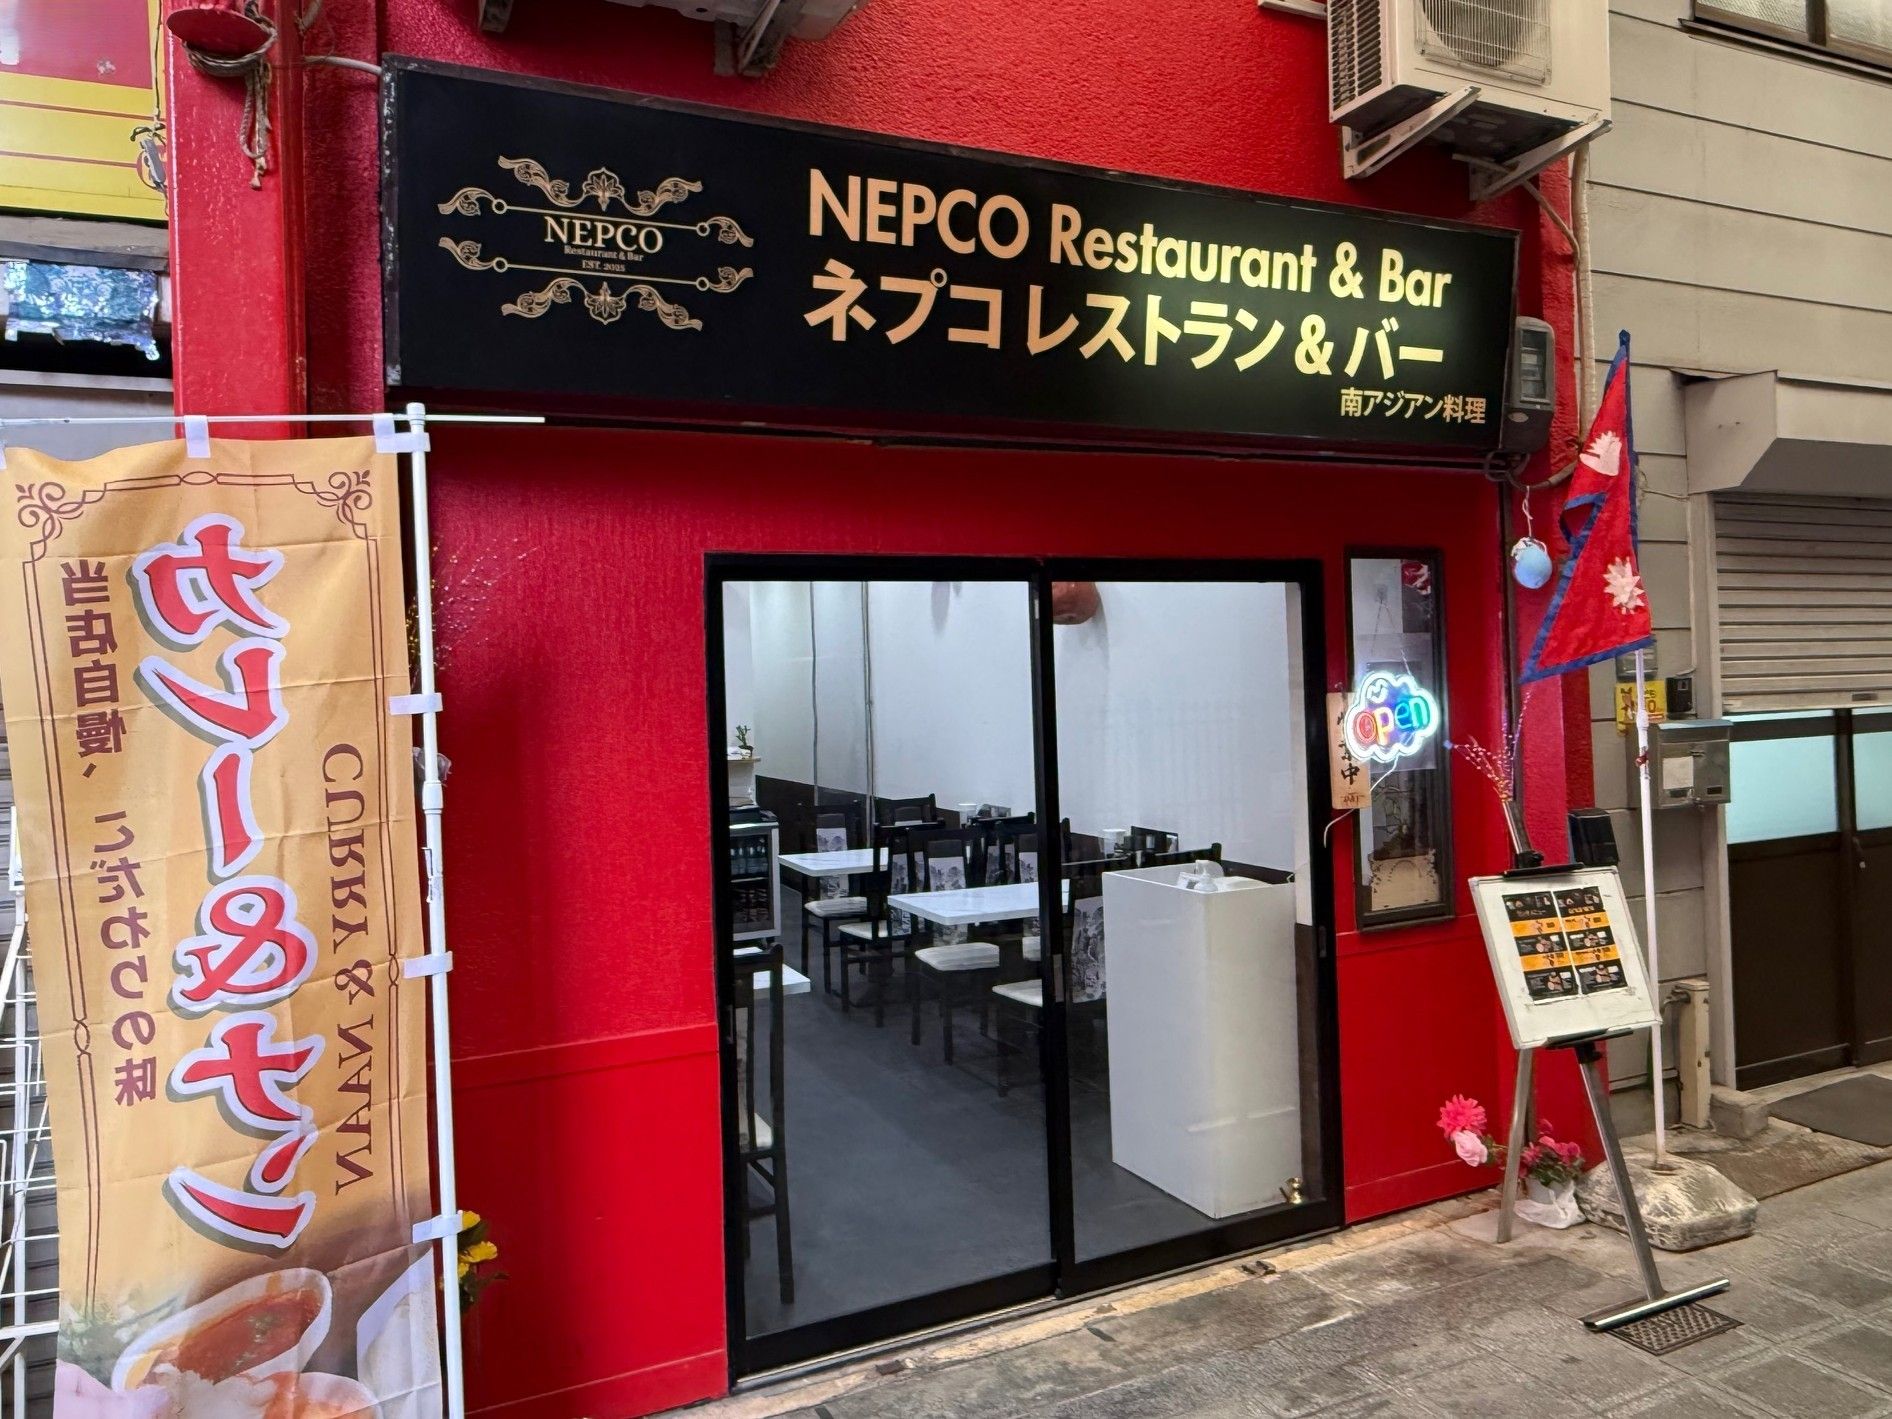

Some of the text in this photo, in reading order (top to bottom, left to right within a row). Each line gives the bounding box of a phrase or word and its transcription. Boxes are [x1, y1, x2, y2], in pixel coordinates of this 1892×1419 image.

[544, 216, 663, 253] NEPCO
[563, 245, 644, 261] Restaurant & Bar
[809, 169, 1453, 308] NEPCO Restaurant & Bar
[1340, 387, 1487, 424] 南アジアン料理
